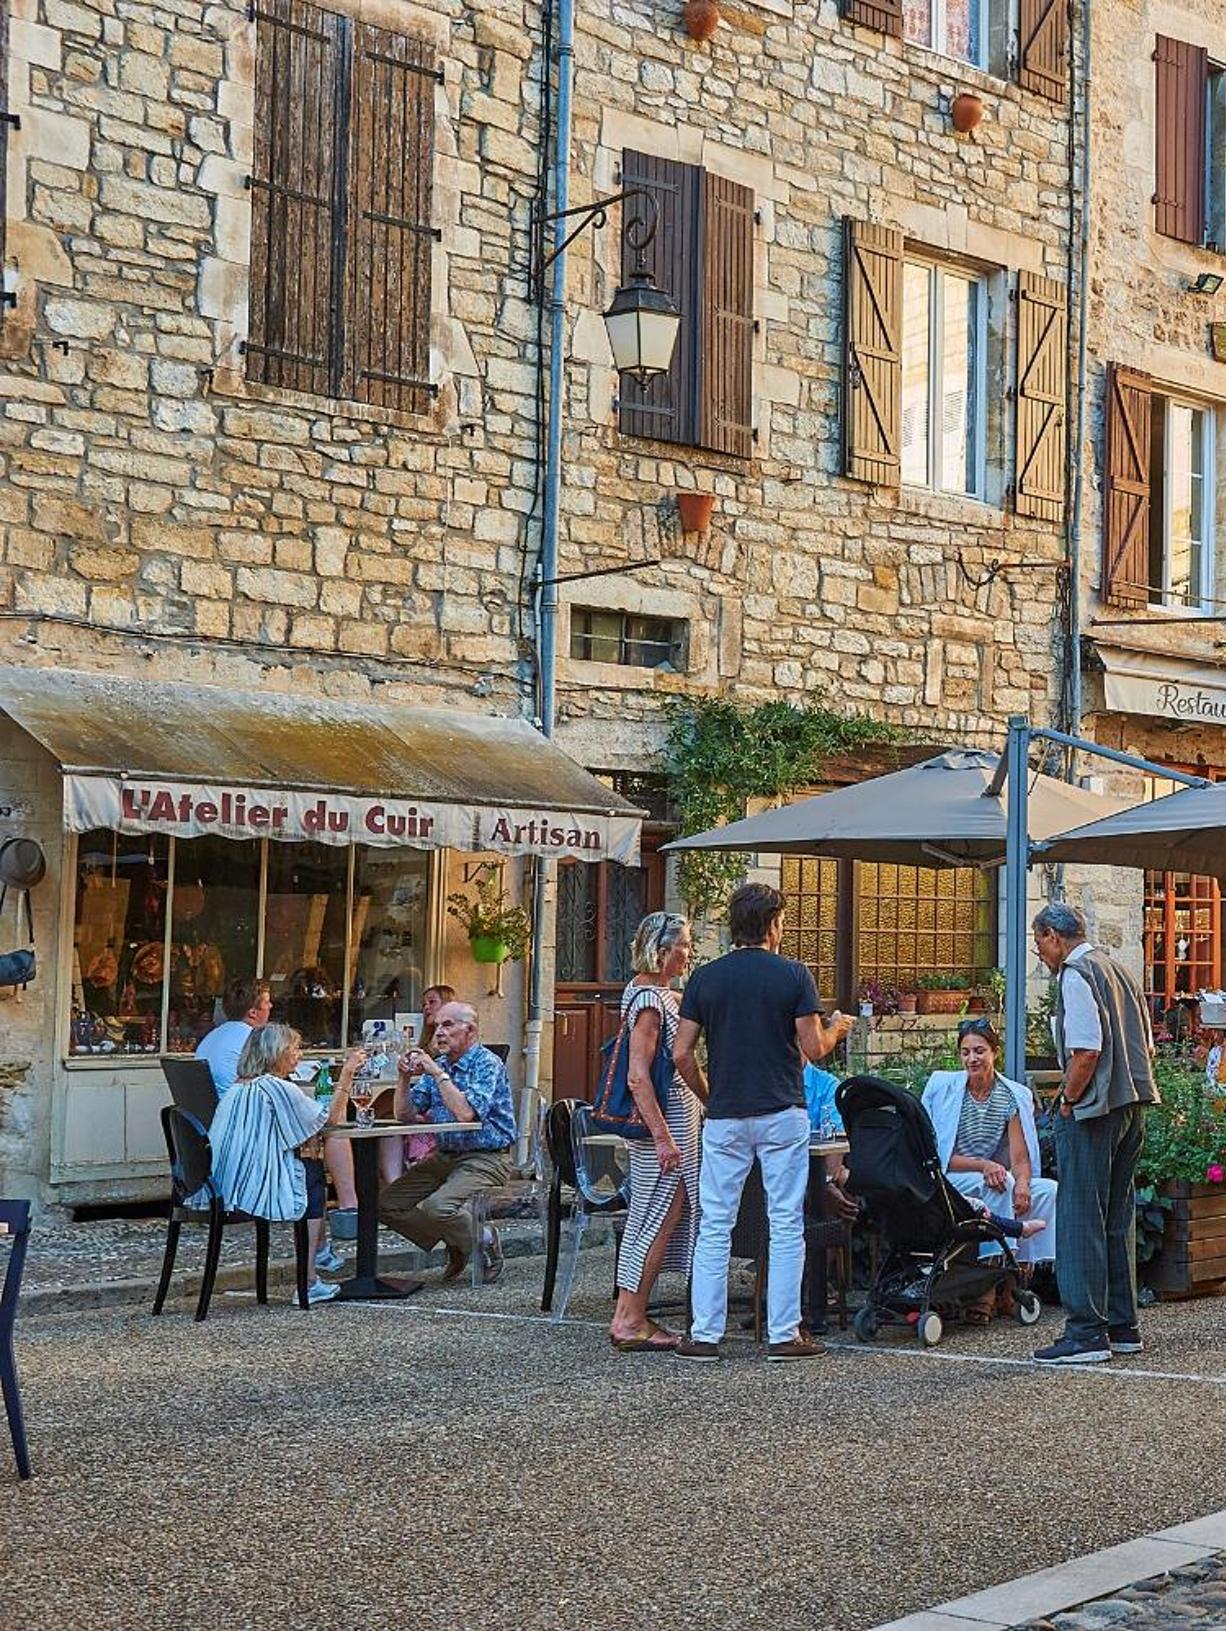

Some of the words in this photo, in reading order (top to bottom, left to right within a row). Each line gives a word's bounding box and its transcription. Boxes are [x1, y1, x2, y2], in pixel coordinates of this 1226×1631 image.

[122, 789, 288, 828] L'Atelier
[303, 801, 349, 832] du
[365, 806, 433, 838] Cuir
[490, 818, 601, 849] Artisan
